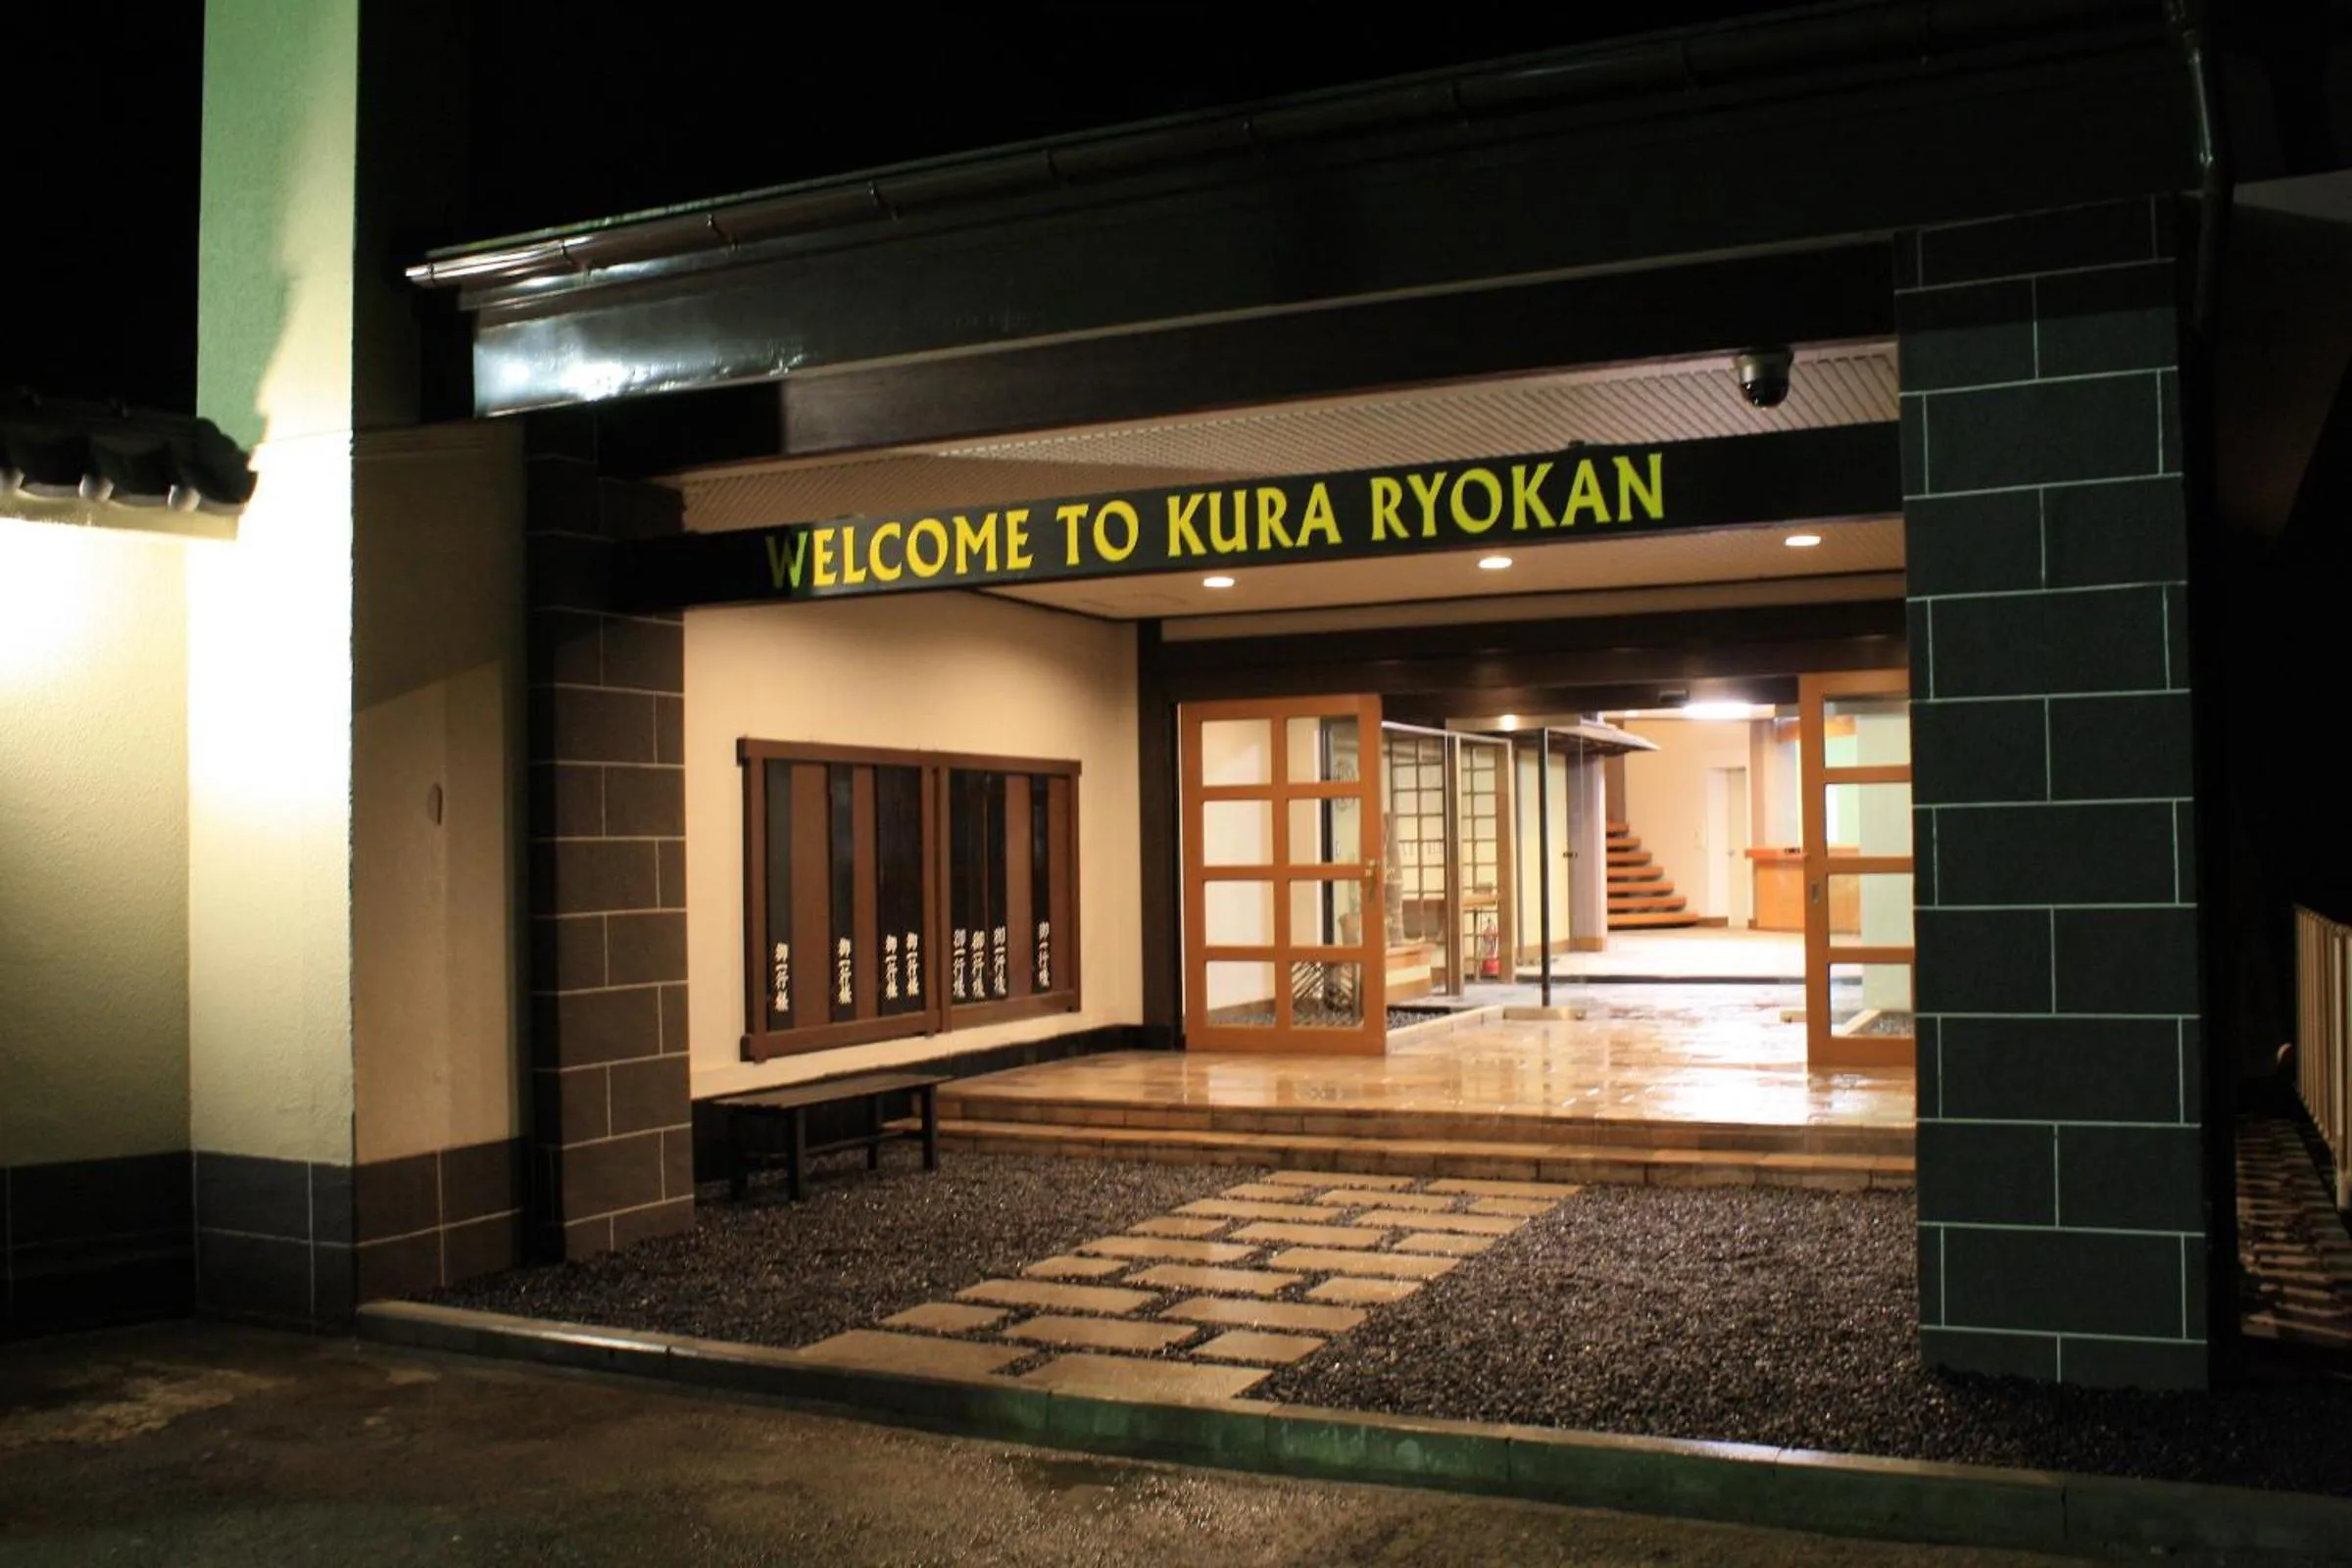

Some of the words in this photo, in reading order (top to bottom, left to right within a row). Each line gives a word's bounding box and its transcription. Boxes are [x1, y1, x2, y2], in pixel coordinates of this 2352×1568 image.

[764, 509, 1032, 589] WELCOME
[1055, 500, 1140, 565] TO
[1166, 481, 1343, 558] KURA
[1370, 453, 1664, 541] RYOKAN
